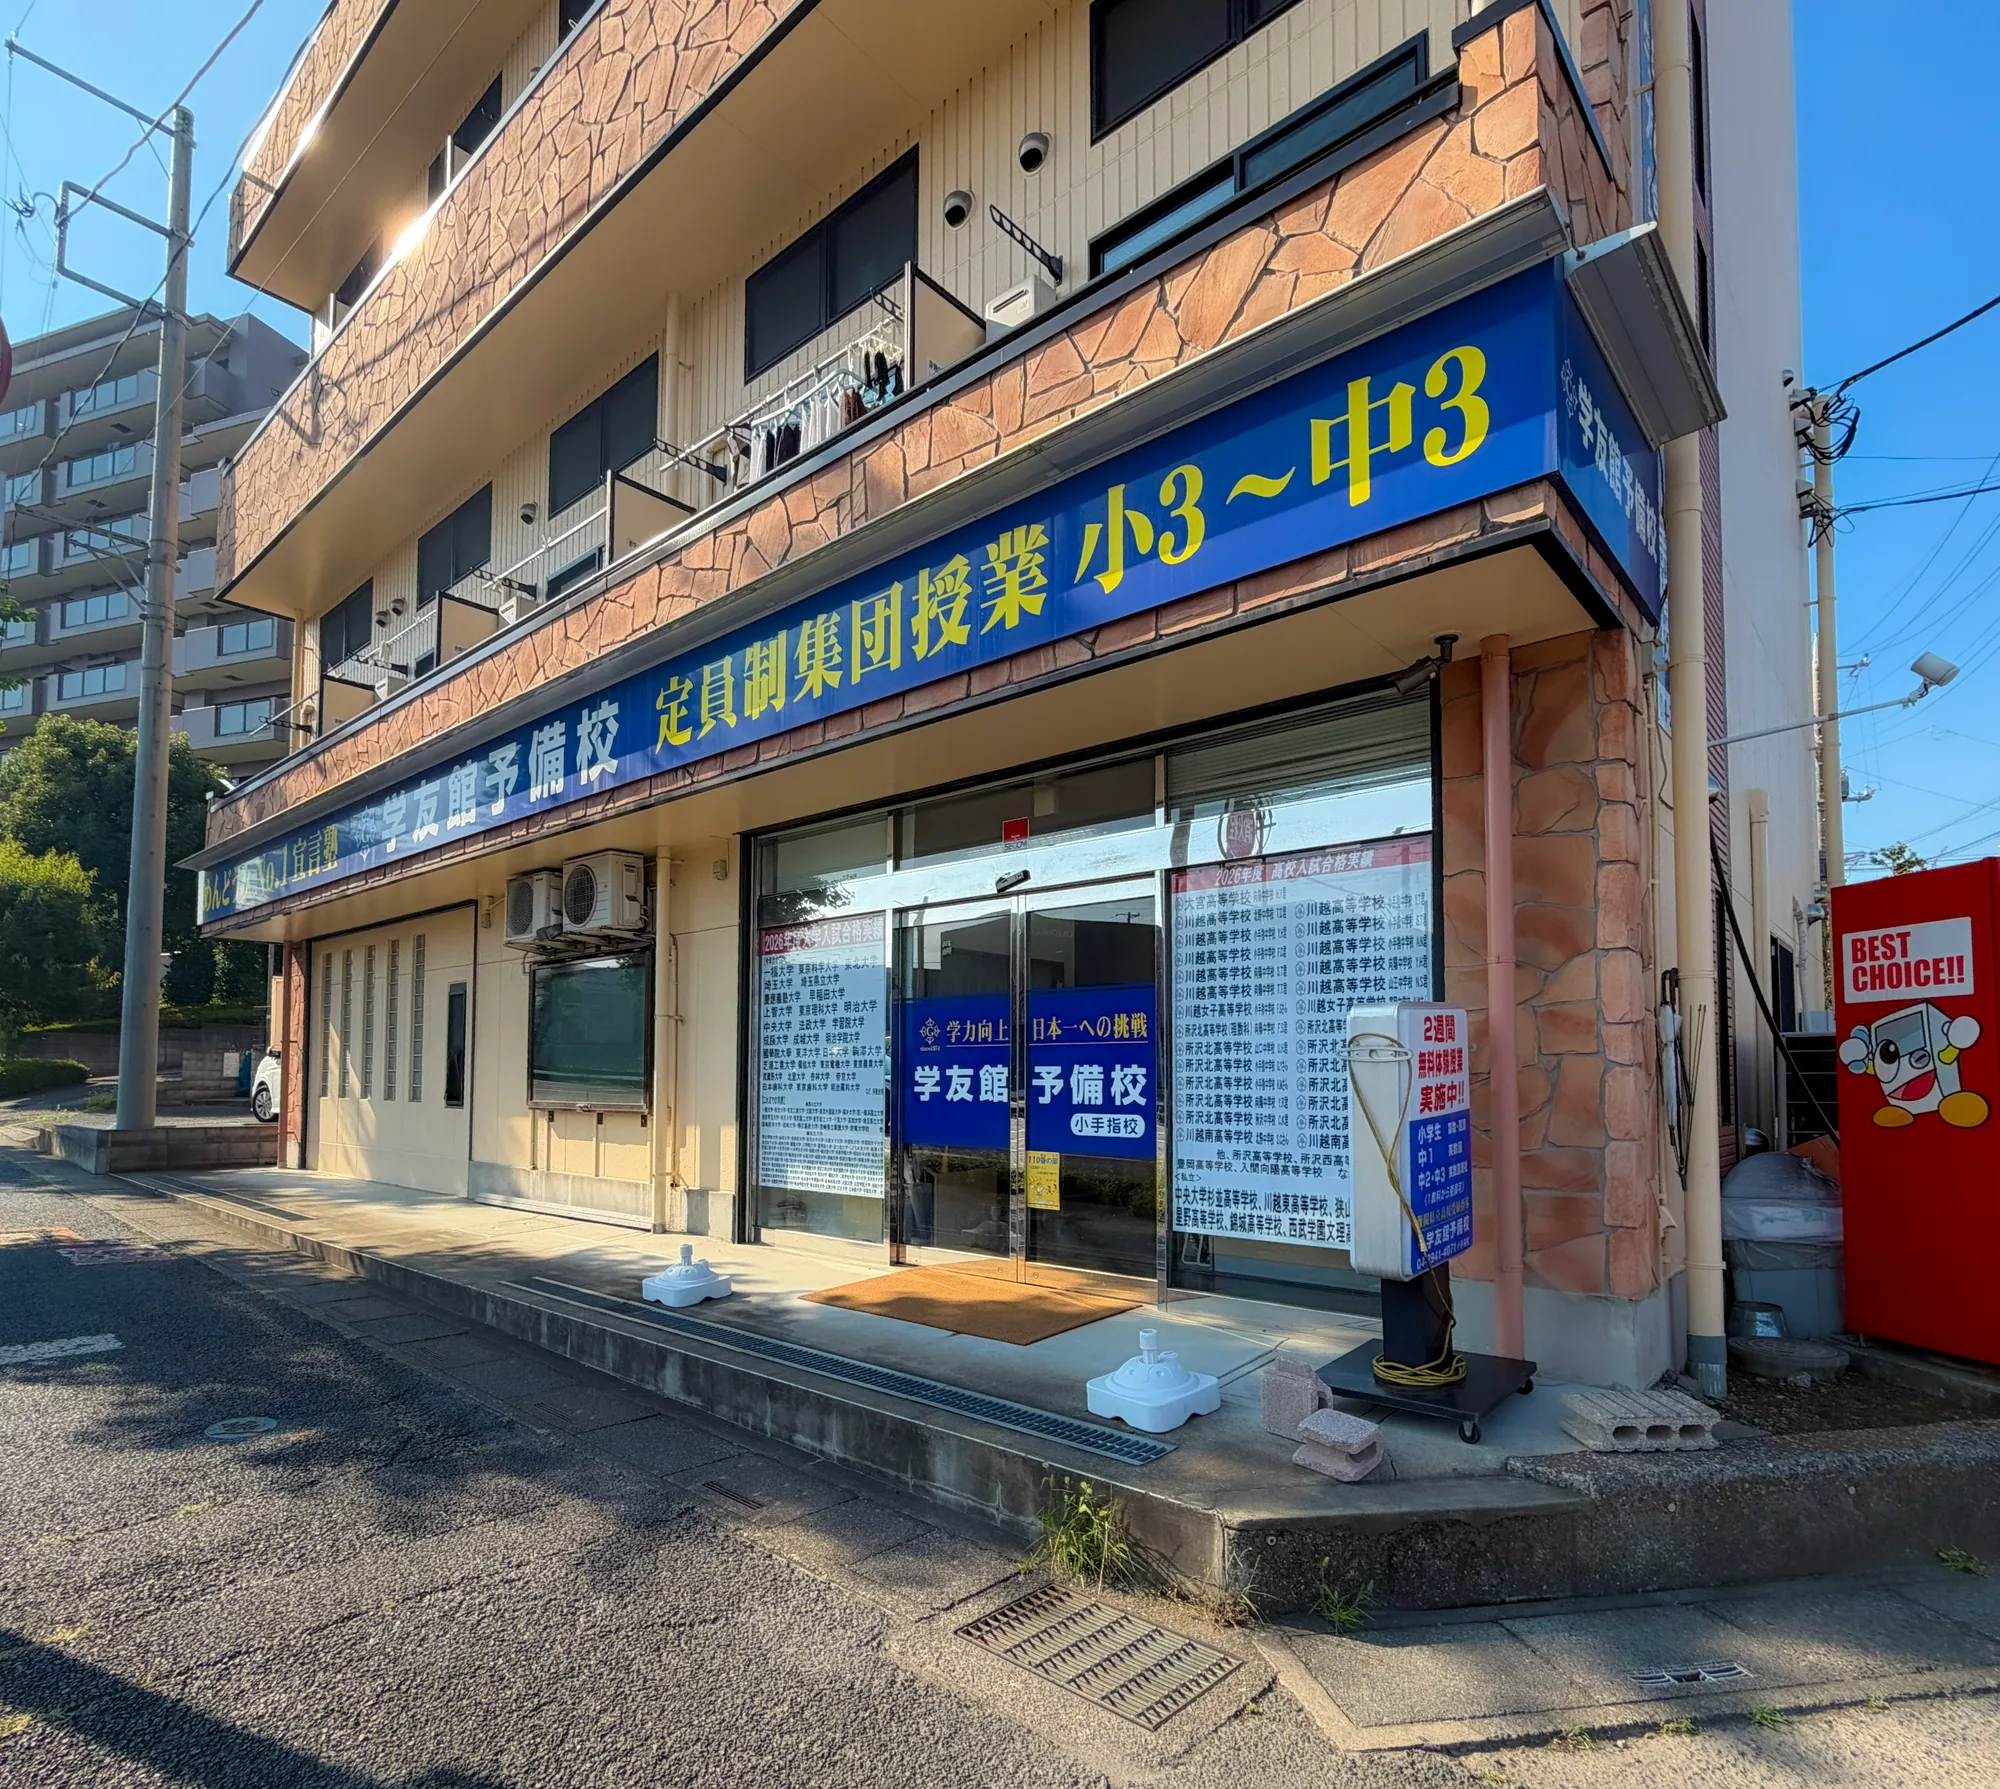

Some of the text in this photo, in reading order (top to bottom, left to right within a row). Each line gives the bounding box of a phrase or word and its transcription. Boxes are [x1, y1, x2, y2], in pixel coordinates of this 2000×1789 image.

[1578, 377, 1657, 564] 学友館予備校
[655, 524, 1050, 753] 定員制集団授業
[382, 700, 619, 853] 学友館予備校
[1215, 850, 1375, 887] 2026年度 高校入試合格実績
[1184, 890, 1251, 911] 大宮高等学校
[1307, 894, 1385, 916] 川越高等学校
[1185, 909, 1251, 928] 川越高等学校
[1307, 915, 1385, 936] 川越高等学校
[1185, 928, 1252, 947] 川越高等学校
[1307, 935, 1385, 956] 川越高等学校
[1851, 931, 1911, 964] BEST
[1185, 947, 1252, 965] 川越高等学校
[1307, 955, 1385, 975] 川越高等学校
[1185, 965, 1252, 983] 川越高等学校
[1852, 955, 1965, 992] CHOICE!!
[809, 987, 846, 1001] 早稲田大学
[1185, 983, 1252, 1000] 川越高等学校
[1307, 974, 1386, 995] 川越高等学校
[764, 1000, 878, 1018] 上智大学 東京理科大学 明治大学
[1185, 1002, 1252, 1018] 川越女子高等学校
[763, 1016, 865, 1032] 中央大学 法政大学 学習院大学
[946, 1012, 1147, 1043] 学力向上 日本一への挑戦
[1423, 1014, 1456, 1043] 2週間
[825, 1031, 860, 1044] 明治学院大学
[796, 1047, 820, 1058] 東洋大学
[1185, 1041, 1252, 1055] 所沢北高等学校
[1185, 1058, 1253, 1072] 所沢北高等学校
[913, 1064, 1147, 1107] 学友館 予備校
[1185, 1076, 1253, 1090] 所沢北高等学校
[1185, 1093, 1253, 1109] 所沢北高等学校
[1419, 1080, 1465, 1114] 実施中!!
[1074, 1117, 1139, 1136] 小手指校
[1185, 1110, 1253, 1126] 所沢北高等学校
[1186, 1128, 1253, 1145] 川越南高等学校
[1418, 1122, 1442, 1145] 小学生
[1418, 1147, 1433, 1167] 中1
[1418, 1167, 1446, 1190] 中2・中3
[1426, 1215, 1470, 1250] 学友館予備校
